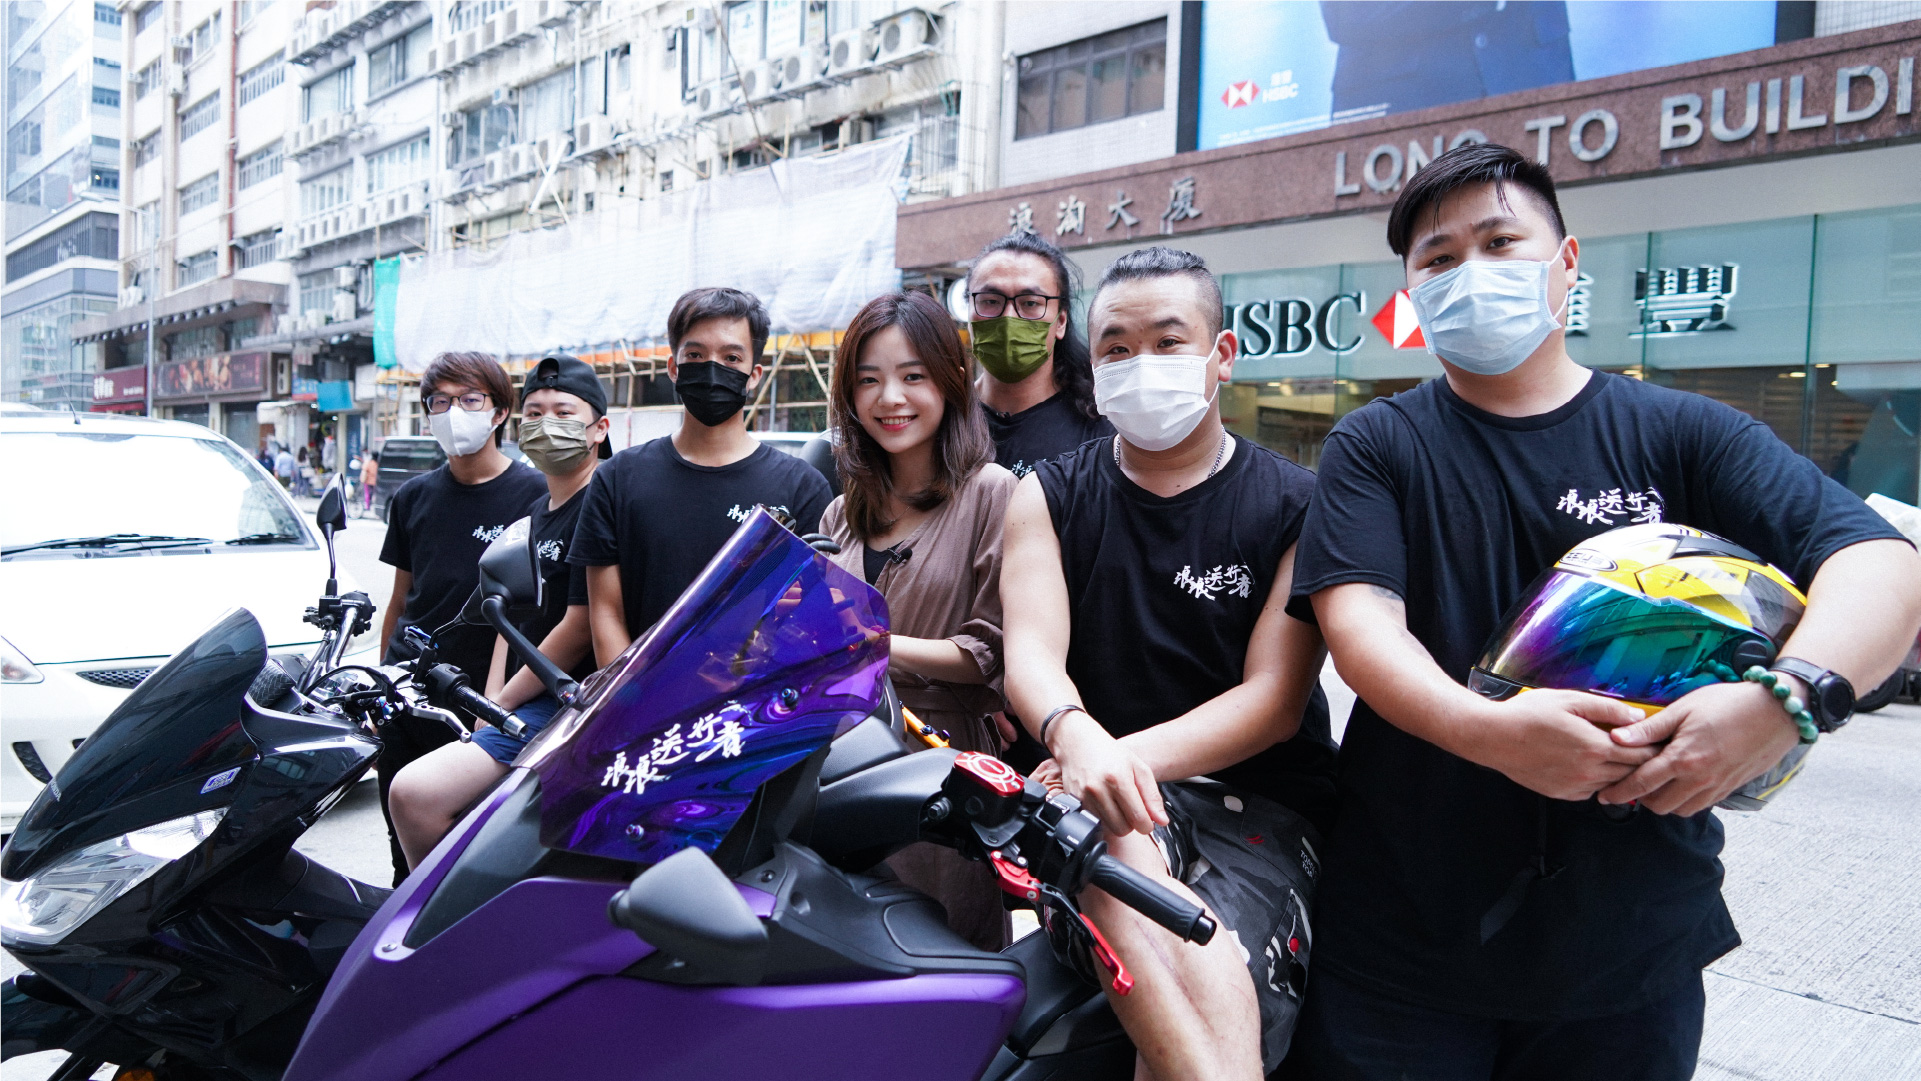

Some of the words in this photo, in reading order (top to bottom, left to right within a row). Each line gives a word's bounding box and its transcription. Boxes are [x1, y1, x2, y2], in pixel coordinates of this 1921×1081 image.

[1524, 107, 1619, 166] TO
[1659, 57, 1914, 151] BUILDI
[1173, 564, 1252, 601] 浪浪送行者
[600, 713, 746, 795] 浪浪送行者
